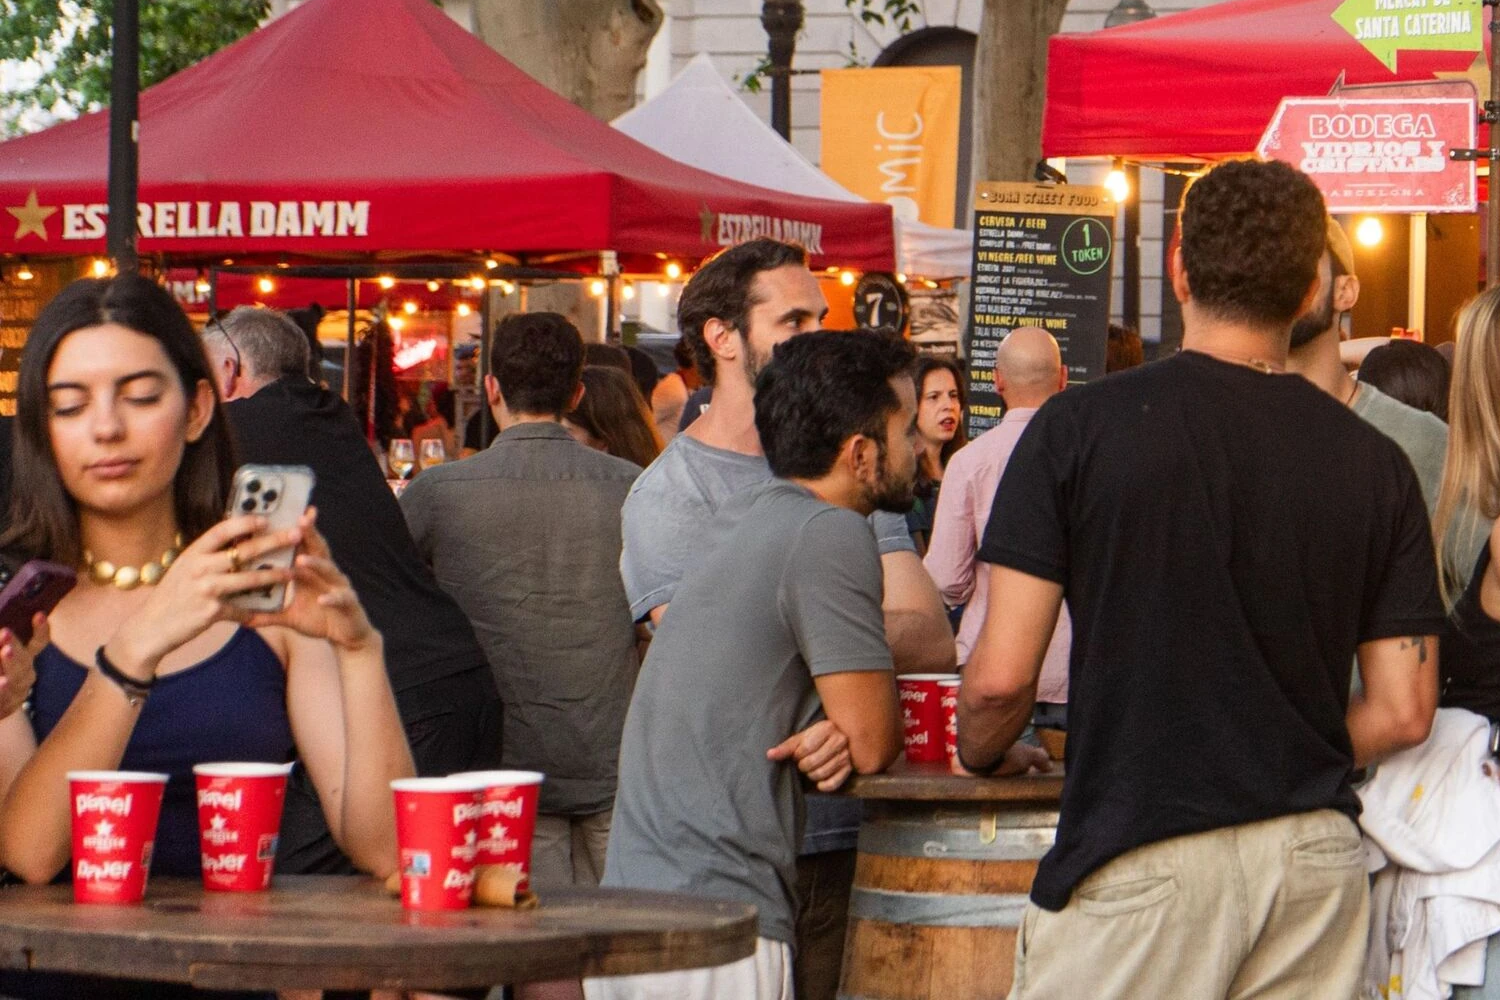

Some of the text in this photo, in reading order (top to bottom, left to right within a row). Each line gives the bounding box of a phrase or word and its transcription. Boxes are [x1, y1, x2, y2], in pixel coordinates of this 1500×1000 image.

[1355, 10, 1472, 40] SANTA CATERINA
[1308, 114, 1436, 138] BODEGA
[1300, 140, 1446, 158] VIDRIOS Y
[1300, 156, 1446, 173] CRISTALES
[1024, 192, 1065, 205] STREET
[62, 200, 371, 240] ESRELLA DAMM
[980, 215, 1016, 228] CERVESA
[1025, 218, 1047, 230] BEER
[718, 212, 824, 255] ESTRELLA DAMM
[1082, 223, 1091, 247] 1
[978, 252, 987, 262] VI
[988, 252, 1014, 263] NEGRE
[1036, 254, 1057, 266] WINE
[1072, 247, 1104, 262] TOKEN
[866, 292, 883, 328] 7
[974, 314, 984, 324] VI
[1046, 318, 1068, 329] WINE
[970, 370, 980, 380] VI
[969, 405, 1002, 417] VERMUT
